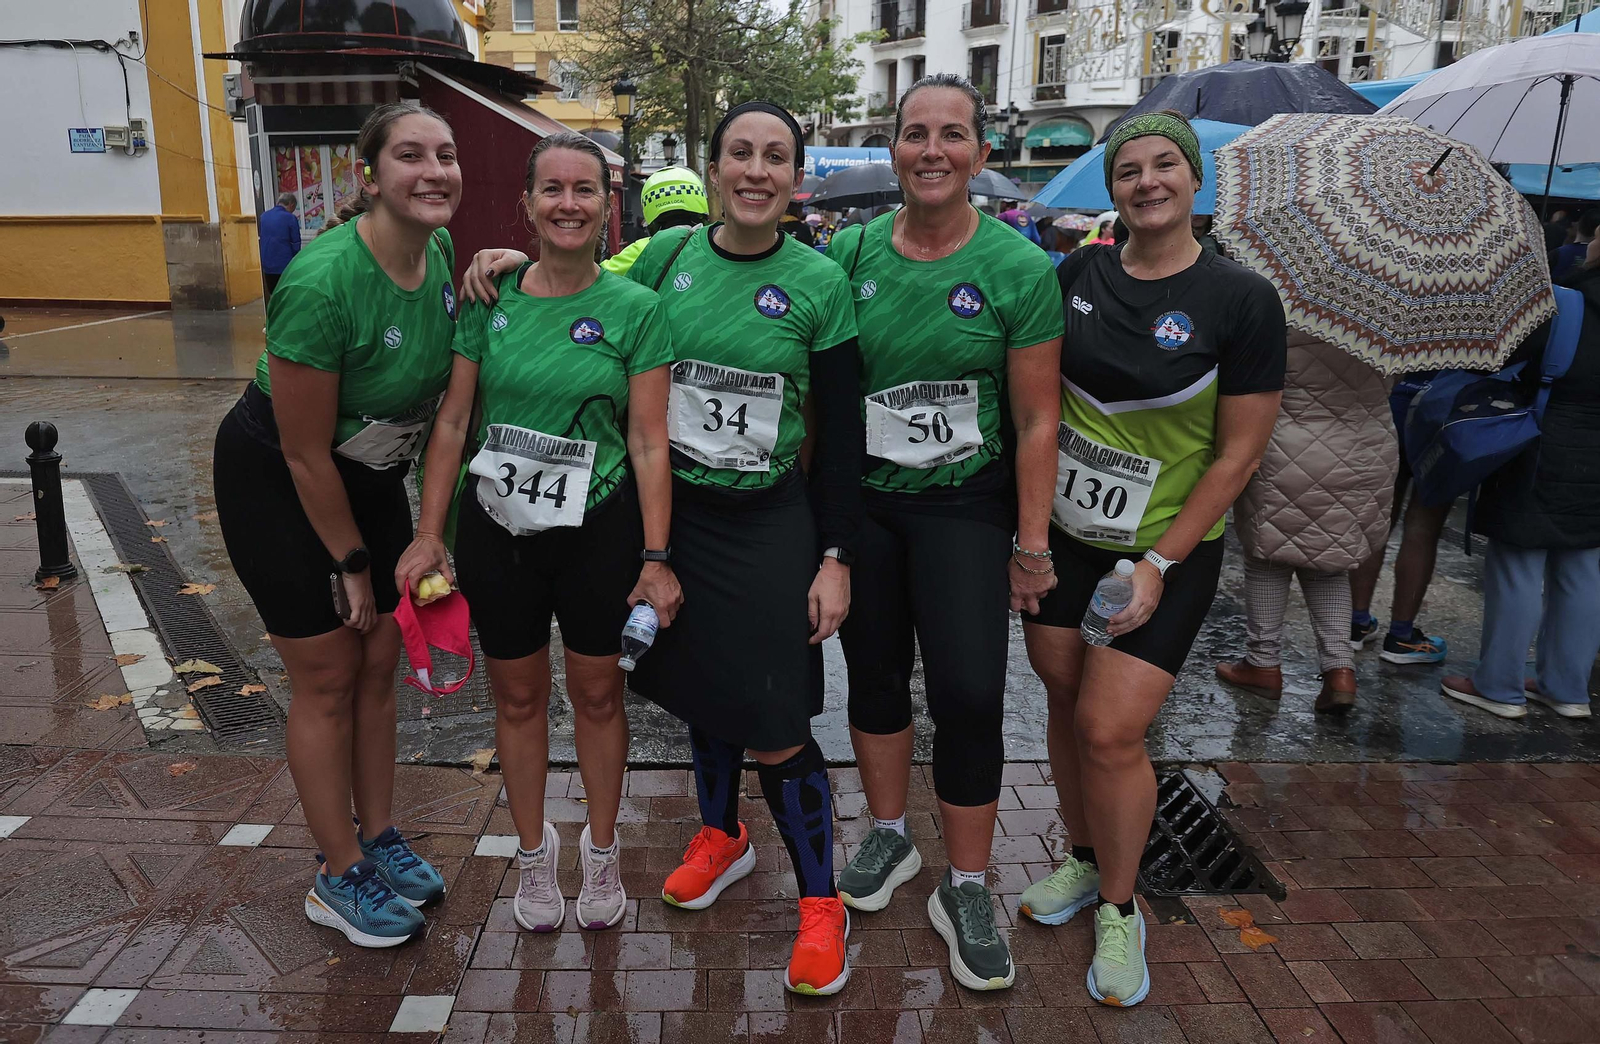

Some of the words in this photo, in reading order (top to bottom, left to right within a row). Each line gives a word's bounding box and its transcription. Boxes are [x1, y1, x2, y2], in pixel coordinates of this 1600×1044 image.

[703, 398, 749, 435] 34
[908, 411, 953, 443] 50
[495, 462, 568, 509] 344
[1060, 469, 1128, 519] 130
